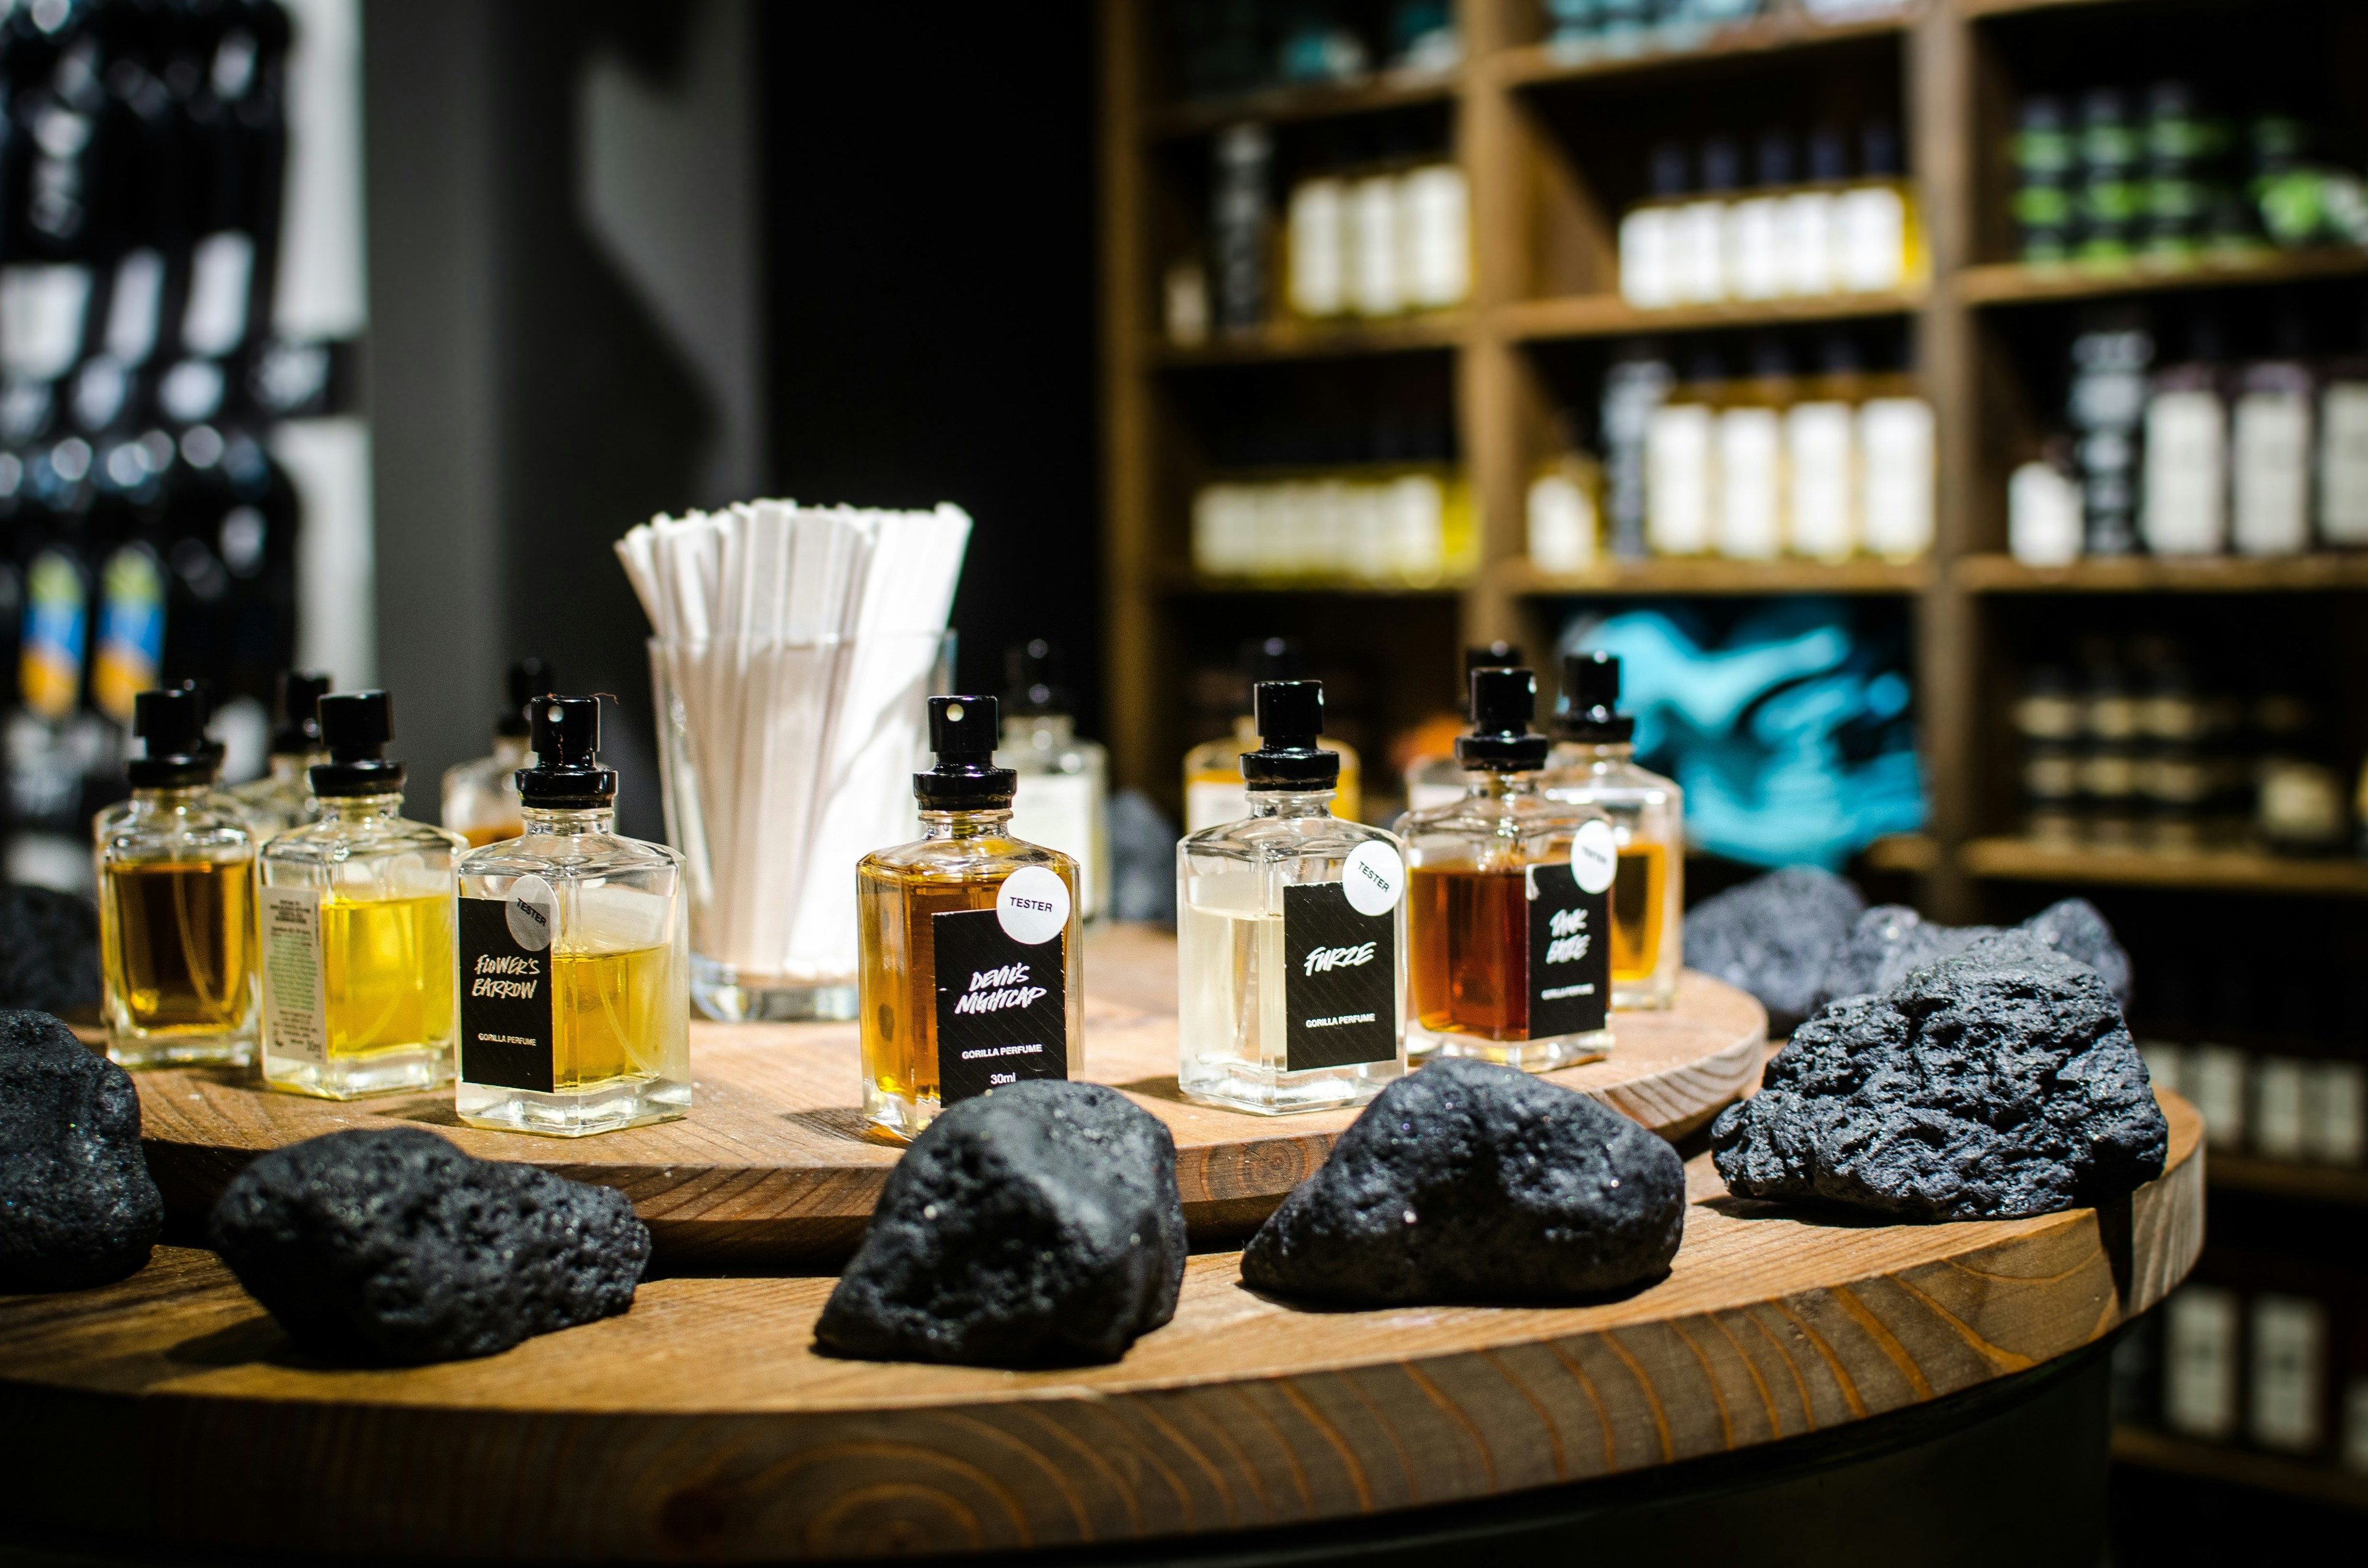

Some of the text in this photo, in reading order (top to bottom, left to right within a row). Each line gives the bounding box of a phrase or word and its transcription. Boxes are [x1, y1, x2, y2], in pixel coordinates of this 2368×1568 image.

[1358, 861, 1389, 893] TESTER
[517, 897, 546, 928] TESTER
[1009, 897, 1053, 912] TESTER
[474, 954, 540, 975] FLOWER'S
[1303, 941, 1377, 977] FURZE
[968, 962, 1031, 992] DEVIL'S
[471, 977, 537, 999] BARROW
[954, 986, 1047, 1015] NIGHTCAP
[1305, 1013, 1376, 1028] GORILLA PERFUME
[477, 1033, 538, 1047] GORILLA PERFUME
[961, 1044, 1043, 1060] GORILLA PERFUME
[990, 1072, 1016, 1085] 30ml
